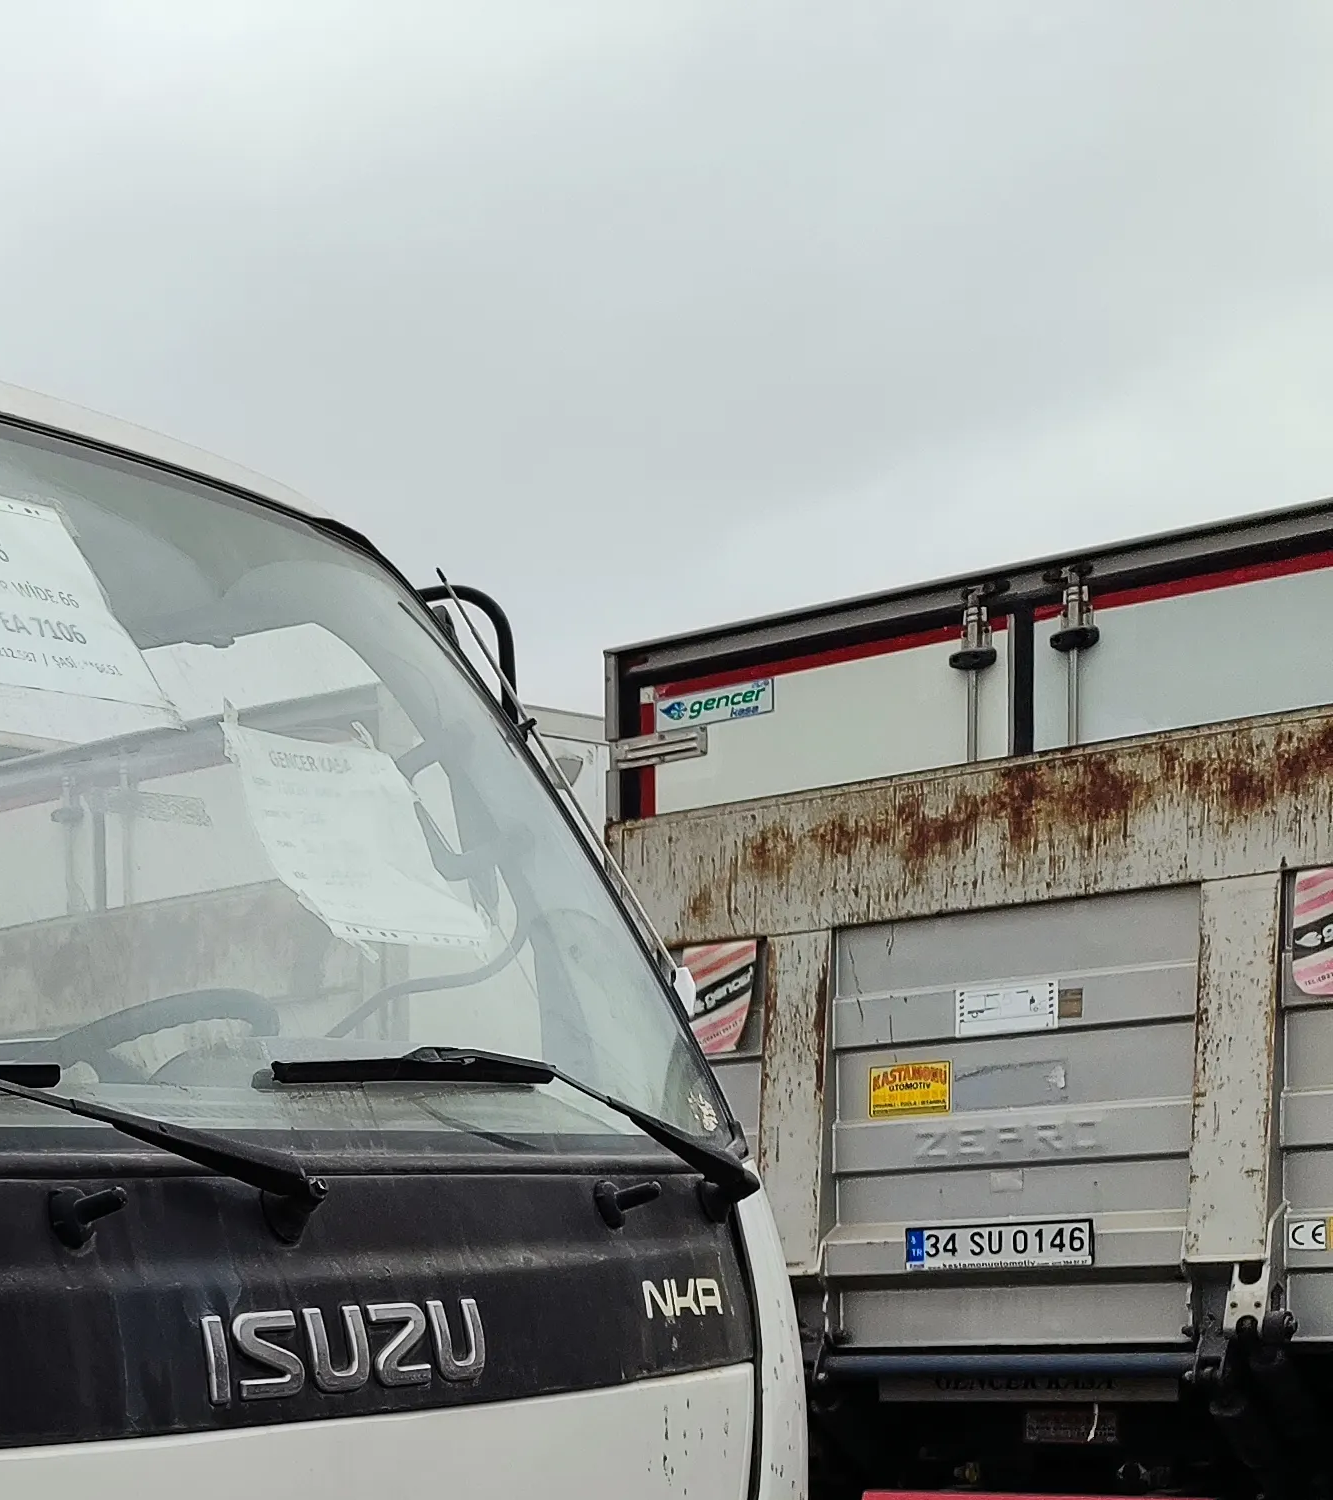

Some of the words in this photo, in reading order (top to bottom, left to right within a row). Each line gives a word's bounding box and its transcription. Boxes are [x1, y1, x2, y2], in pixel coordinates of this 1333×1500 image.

[60, 592, 80, 609] 66
[29, 616, 88, 646] 7106
[689, 687, 766, 719] gencer
[730, 706, 759, 718] kasa
[911, 1248, 923, 1257] TR
[925, 1233, 958, 1258] 34
[970, 1231, 1002, 1256] SU
[1012, 1227, 1085, 1254] 0146
[640, 1278, 725, 1319] NKR
[200, 1297, 487, 1406] ISUZU
